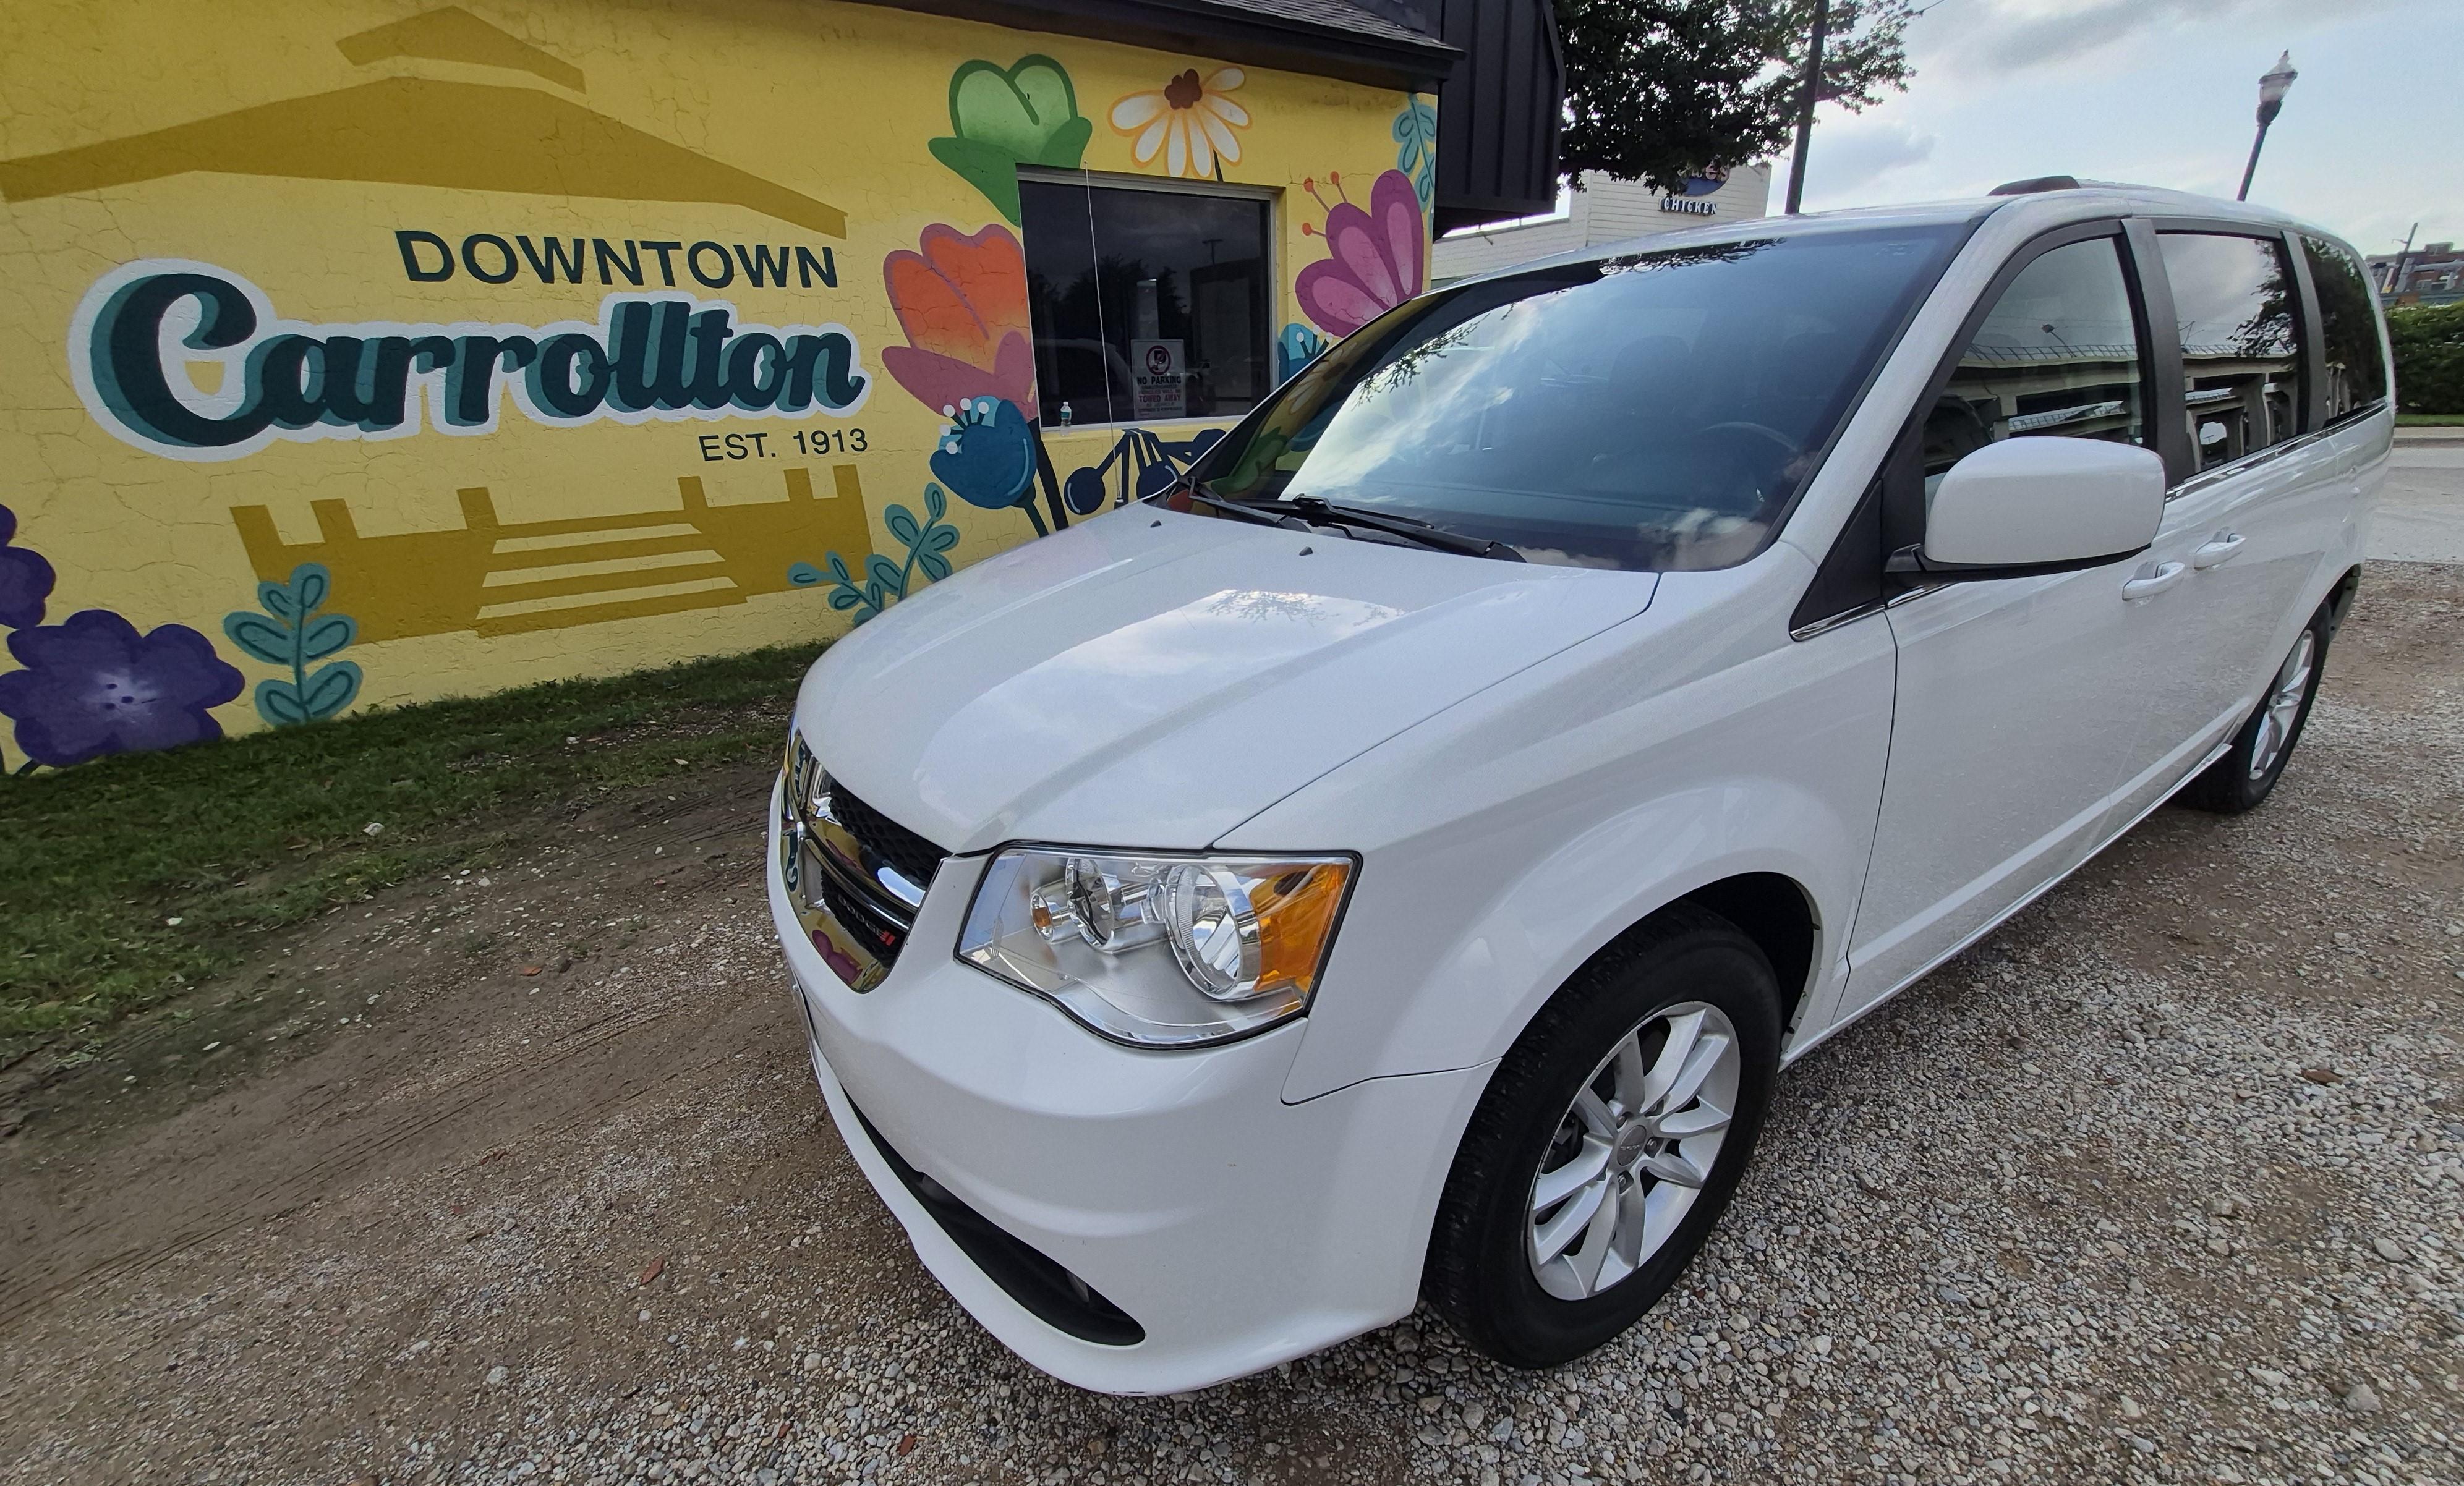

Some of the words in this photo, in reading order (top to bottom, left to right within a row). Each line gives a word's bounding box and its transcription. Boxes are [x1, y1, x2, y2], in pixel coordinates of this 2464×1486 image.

[1663, 197, 1718, 214] CHICKEN
[394, 230, 838, 288] DOWNTOWN
[90, 272, 866, 448] Carrollton
[1136, 376, 1148, 384] NO
[1151, 375, 1182, 384] PARKING
[1164, 394, 1180, 402] AWAY
[699, 433, 776, 462] EST.
[793, 428, 868, 455] 1913
